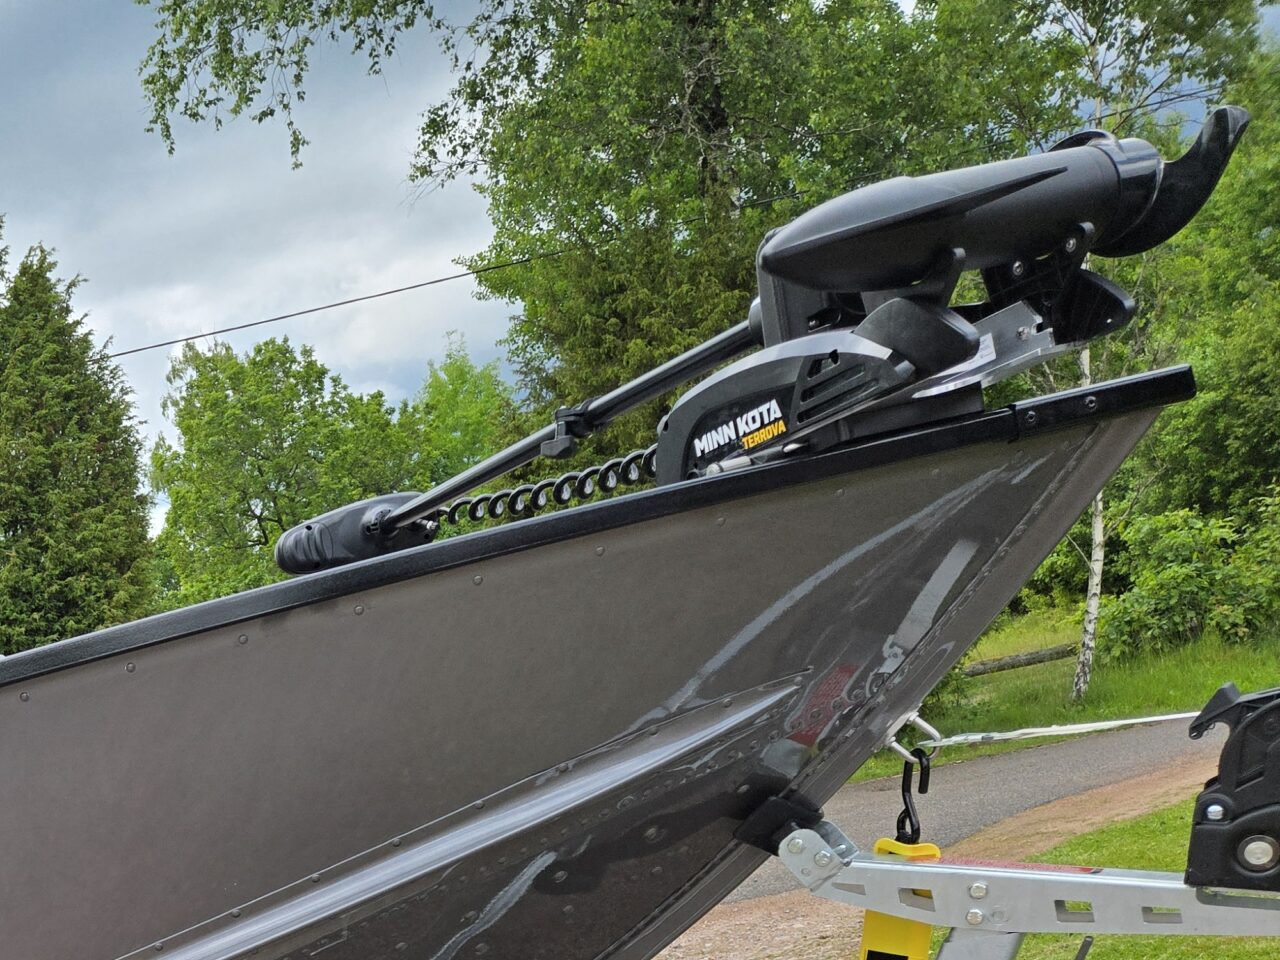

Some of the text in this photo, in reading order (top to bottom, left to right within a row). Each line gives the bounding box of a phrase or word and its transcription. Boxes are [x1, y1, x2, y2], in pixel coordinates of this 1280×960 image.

[694, 398, 783, 458] MINN KOTA
[741, 419, 787, 450] TERROVA
